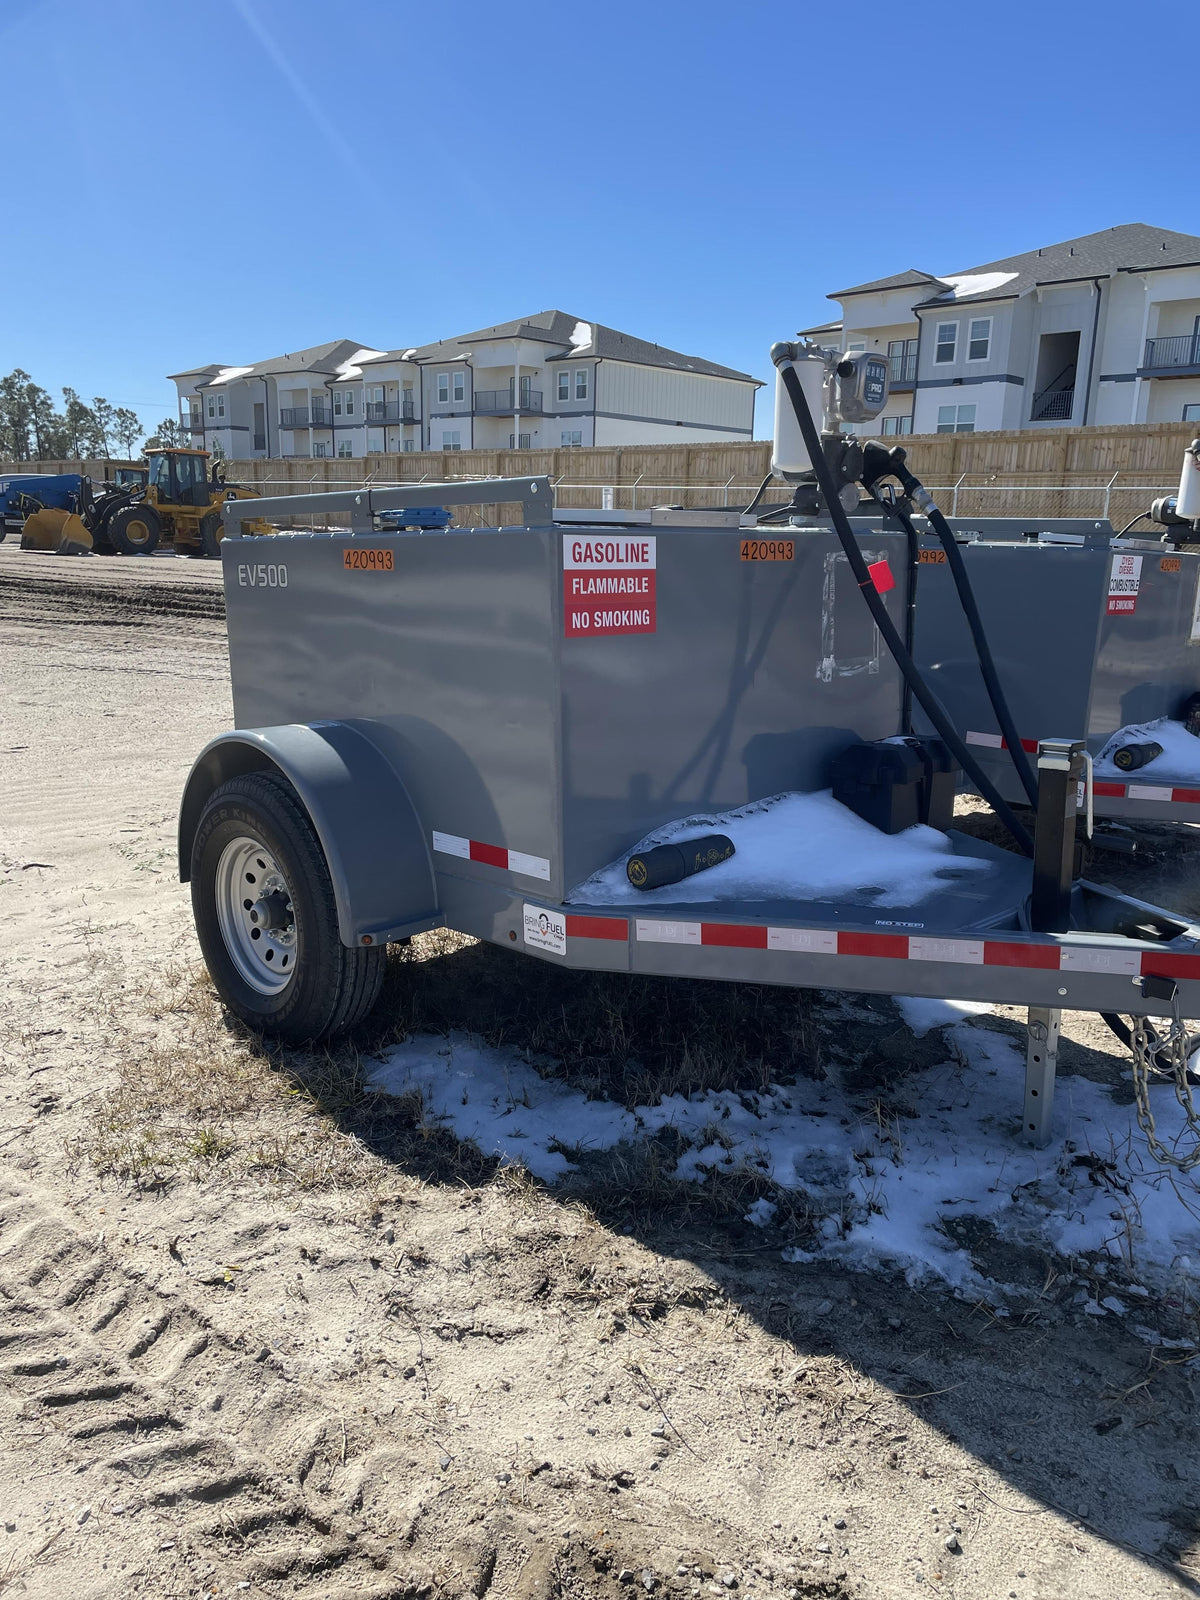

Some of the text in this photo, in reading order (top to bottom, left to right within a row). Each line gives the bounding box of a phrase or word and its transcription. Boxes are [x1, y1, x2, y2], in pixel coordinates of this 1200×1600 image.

[344, 551, 393, 570] 420993
[572, 542, 649, 563] GASOLINE
[741, 542, 793, 561] 420993
[238, 564, 288, 588] EV500
[1119, 566, 1134, 575] DIESEL
[572, 577, 649, 595] FLAMMABLE
[1109, 579, 1140, 591] COMBUSTIBLE
[1108, 600, 1135, 610] NO SMOKING
[572, 609, 650, 629] NO SMOKING
[524, 915, 545, 930] BRING
[546, 922, 565, 936] FUEL
